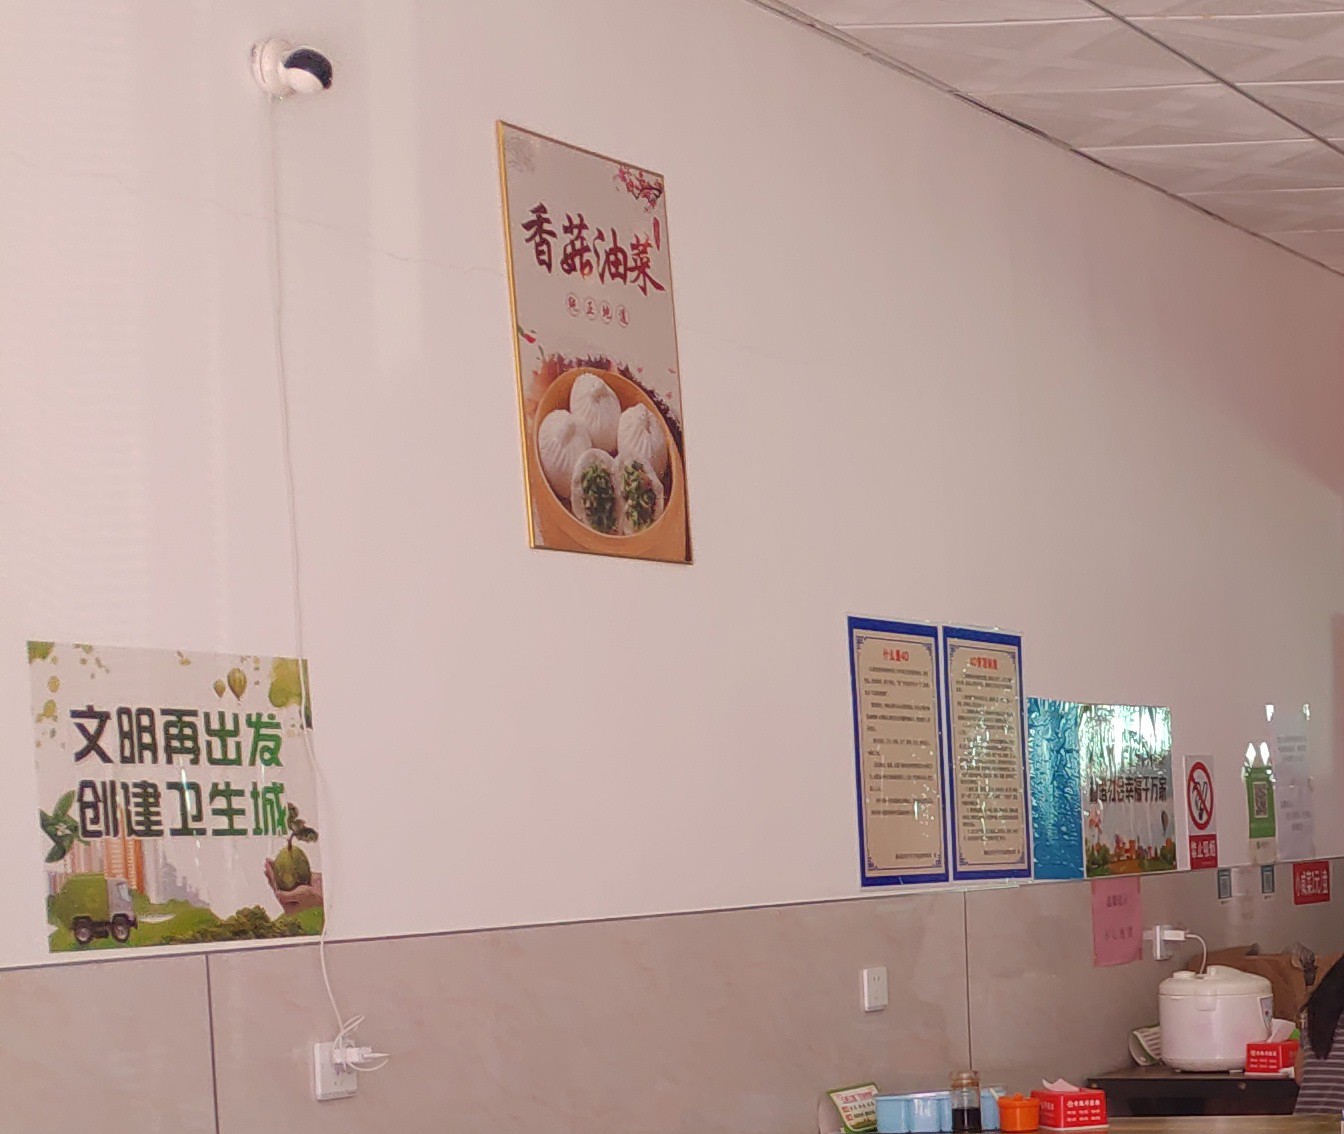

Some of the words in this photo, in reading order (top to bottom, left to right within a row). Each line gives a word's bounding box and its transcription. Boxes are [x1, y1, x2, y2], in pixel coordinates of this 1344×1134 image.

[521, 202, 666, 297] 香菇油菜
[69, 704, 285, 767] 文明再出发
[76, 779, 289, 839] 创建卫生城
